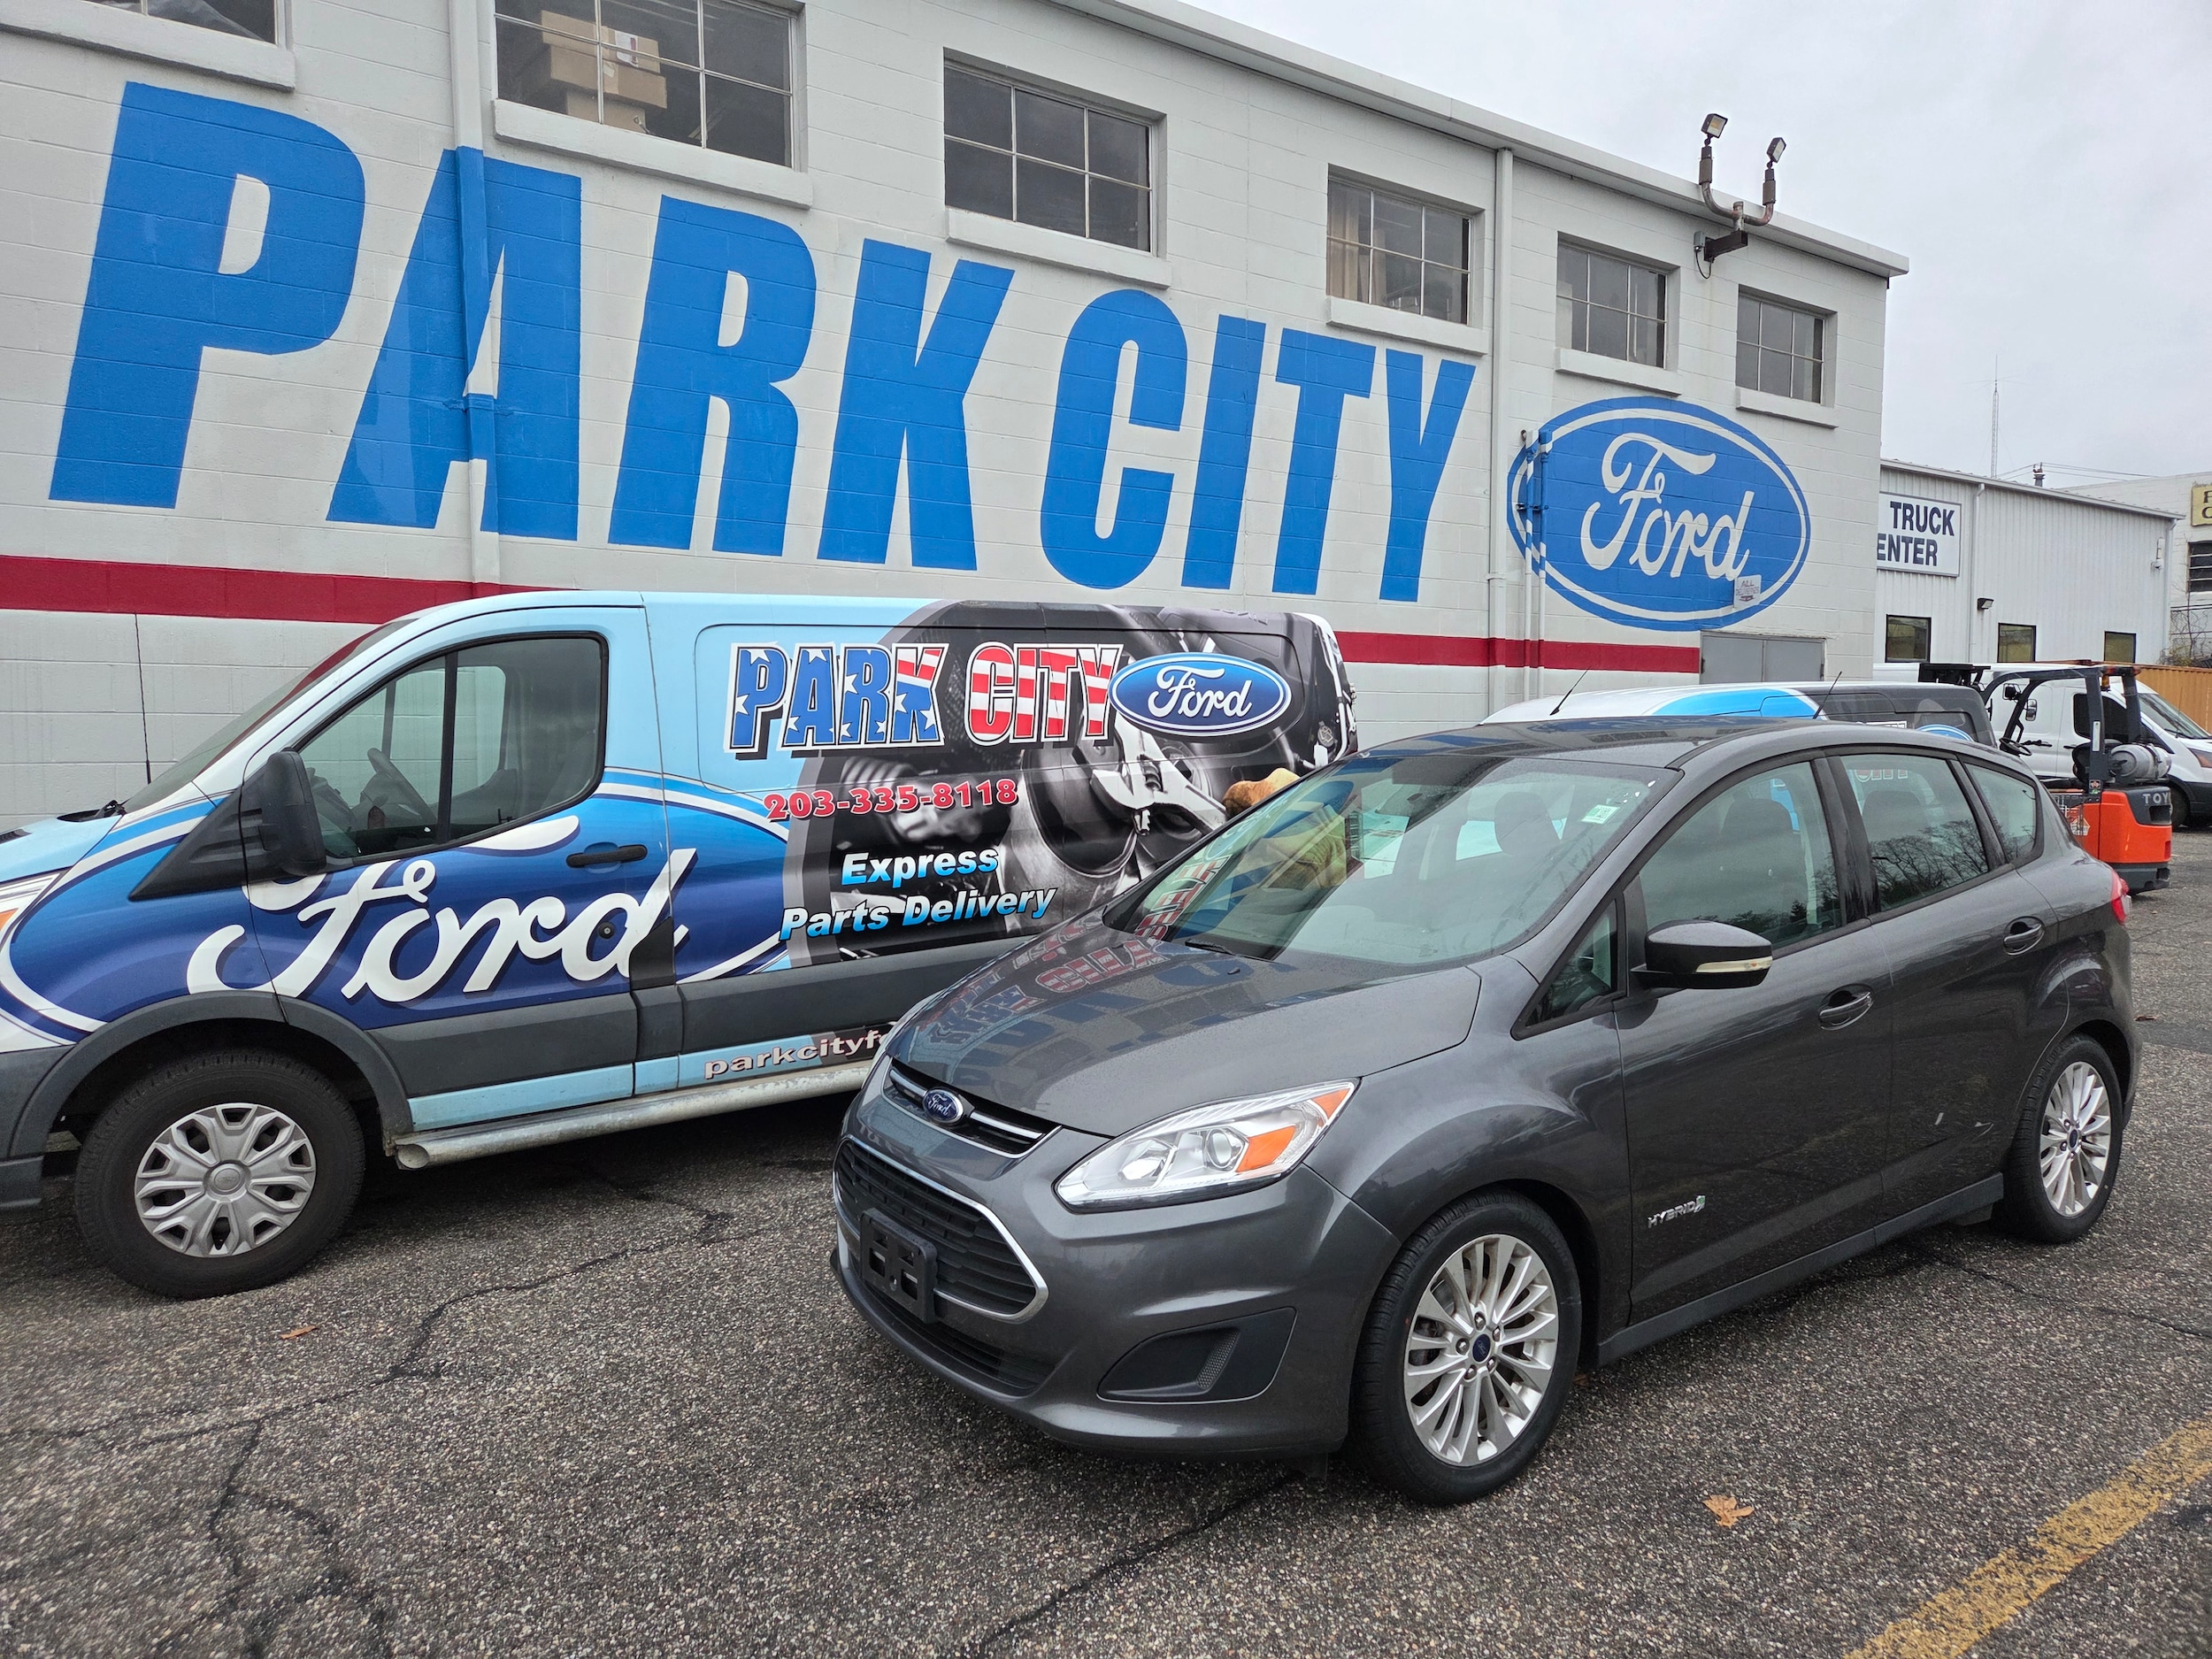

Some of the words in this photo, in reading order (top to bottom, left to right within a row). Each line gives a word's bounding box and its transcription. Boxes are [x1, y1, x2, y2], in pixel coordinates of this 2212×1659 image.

[49, 81, 1015, 571] PARK
[1039, 288, 1476, 603] CITY
[1579, 431, 1755, 582] Ford
[1889, 500, 1955, 537] TRUCK
[723, 641, 949, 753] PARK
[964, 641, 1124, 745] CITY
[1148, 664, 1253, 718] Ford
[764, 778, 1019, 823] 203-335-8118
[2141, 790, 2172, 805] TOY
[841, 847, 1000, 887] Express
[187, 814, 698, 1003] Ford
[778, 894, 890, 943] Parts
[902, 884, 1058, 927] Delivery
[927, 1093, 952, 1117] Ford
[1647, 1200, 1697, 1229] HYBRID
